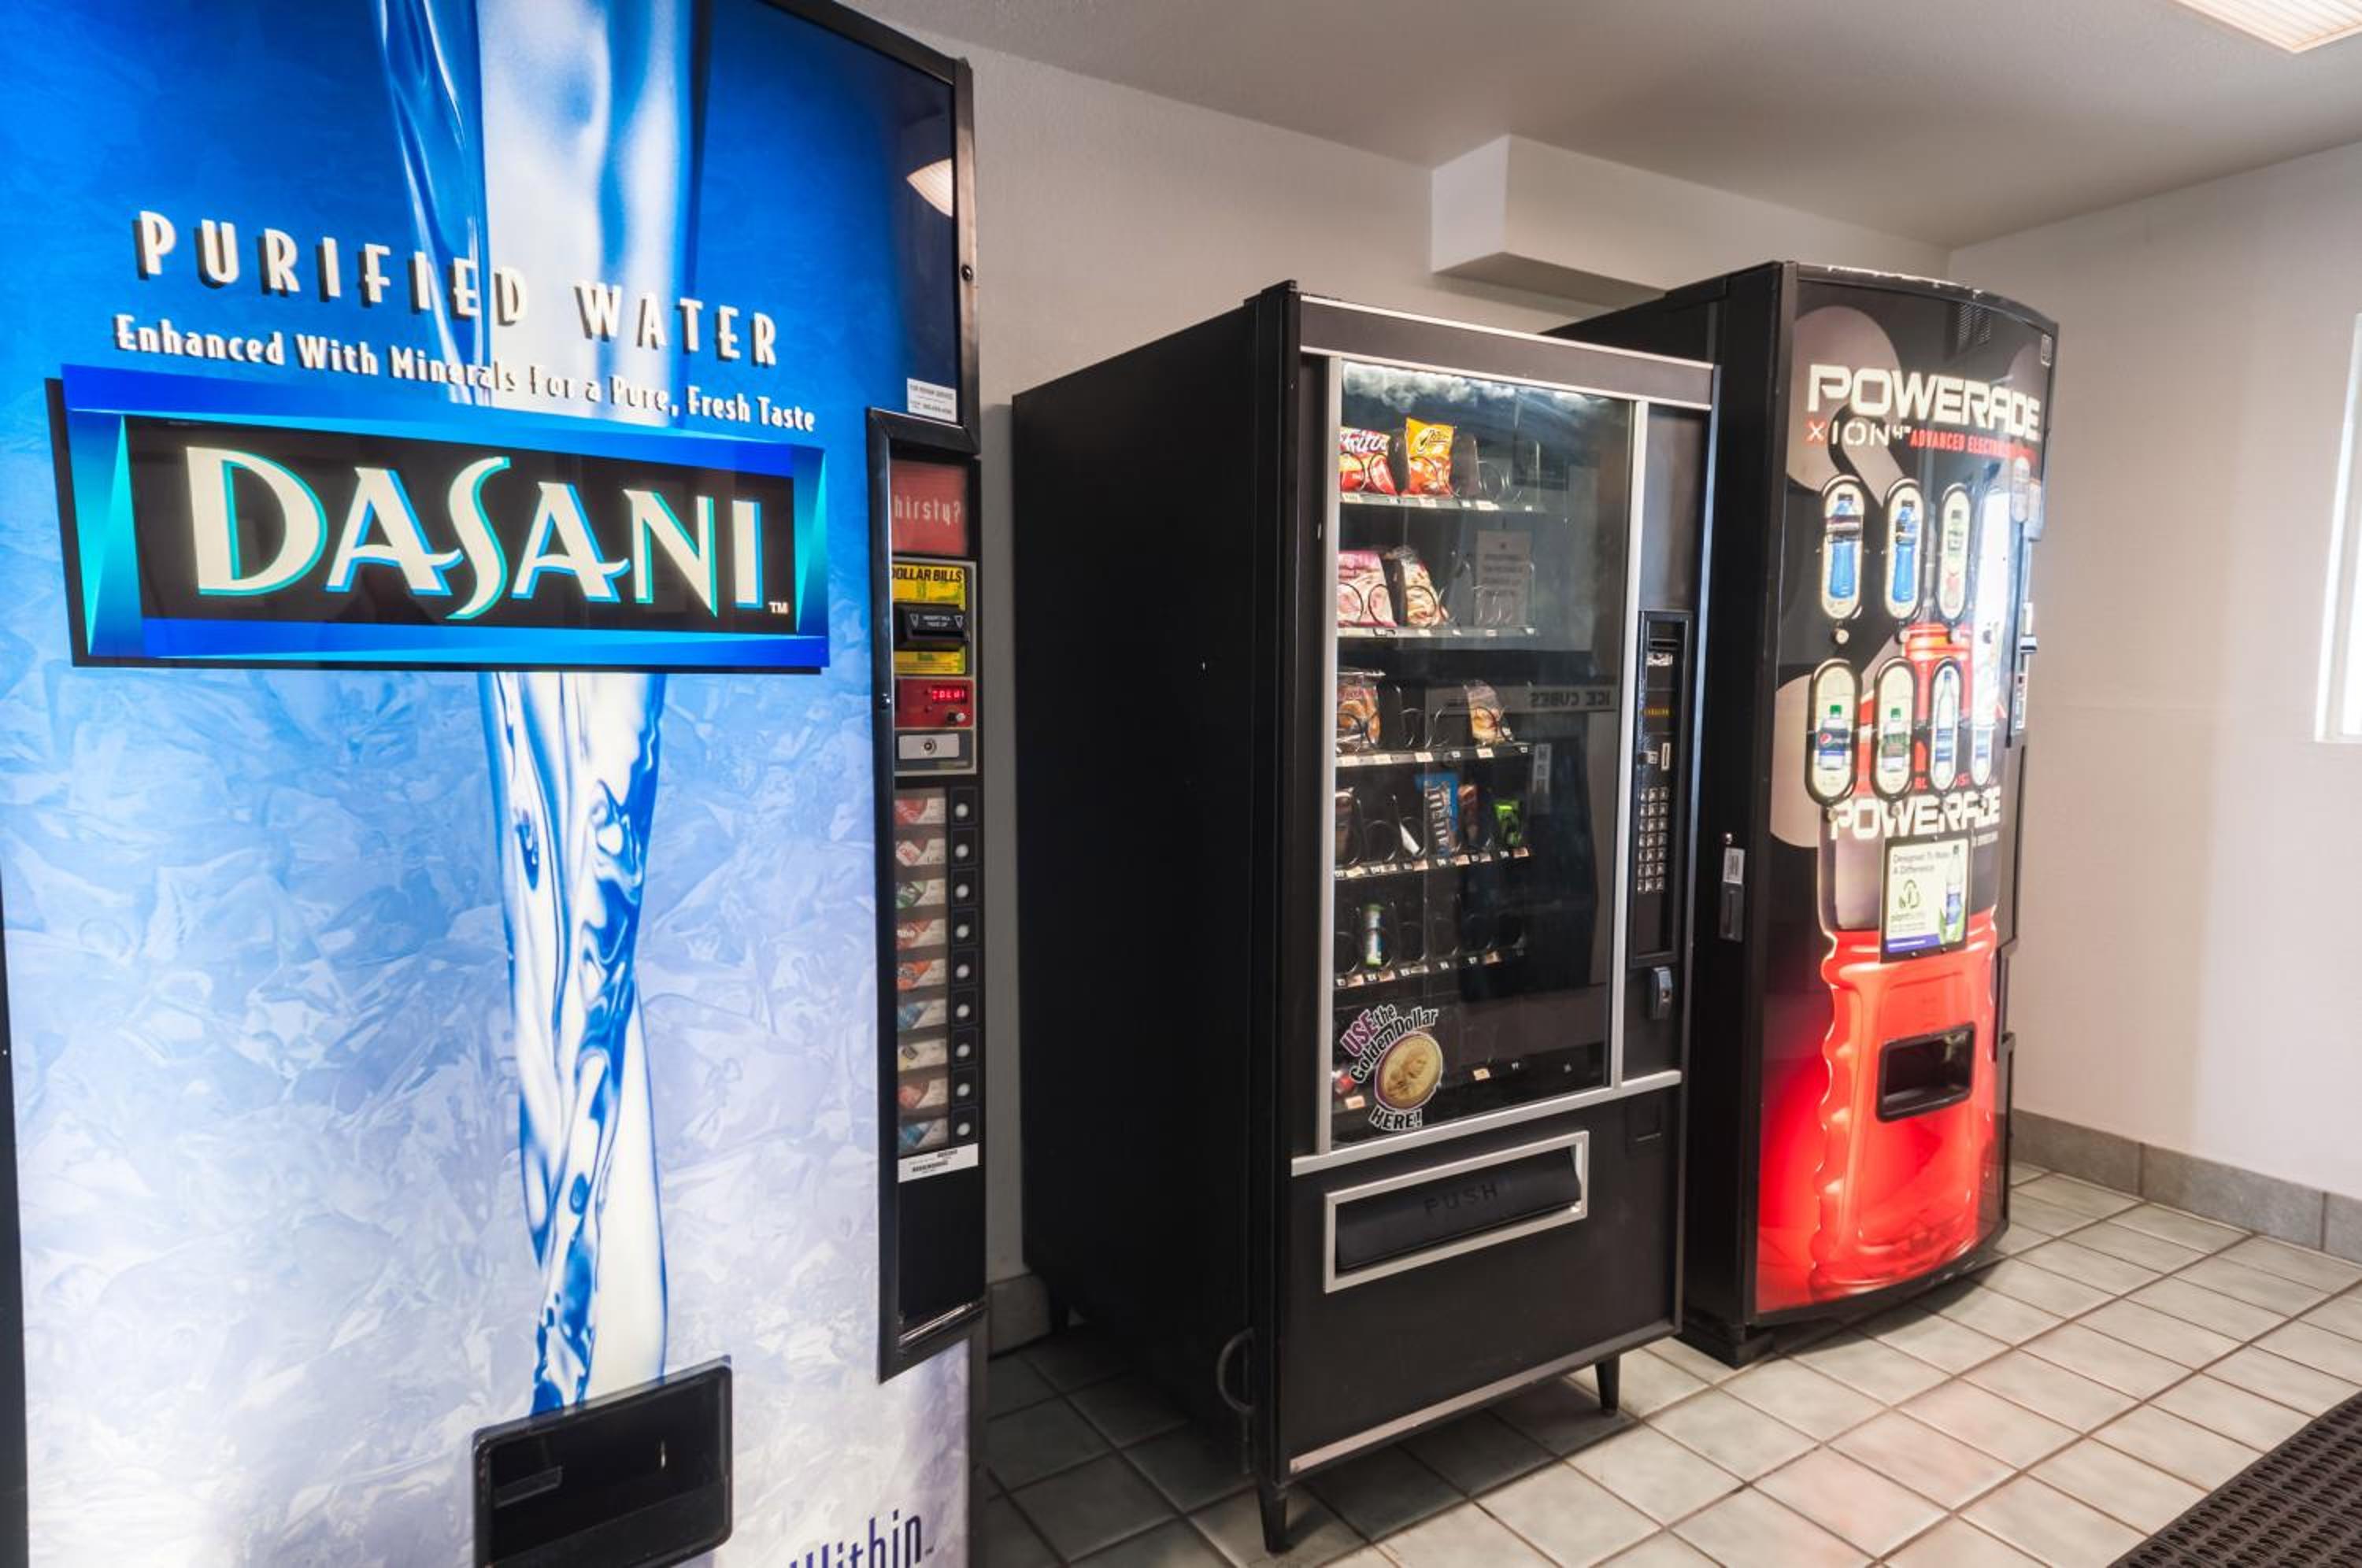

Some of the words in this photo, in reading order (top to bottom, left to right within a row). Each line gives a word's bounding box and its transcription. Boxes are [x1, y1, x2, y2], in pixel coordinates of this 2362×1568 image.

[135, 209, 528, 327] PURIFIED
[574, 279, 778, 366] WATER
[113, 313, 284, 365] Enhanced
[295, 333, 379, 376] With
[391, 344, 516, 392] Minerals
[530, 362, 576, 398] For
[584, 378, 600, 402] a
[609, 373, 679, 417] Pure,
[687, 385, 750, 423] Fresh
[756, 394, 816, 433] Taste
[1807, 364, 2041, 442] POWERADE
[1909, 429, 1966, 453] ADVANCED
[186, 444, 765, 621] DASANI
[894, 494, 961, 526] hirsty?
[933, 569, 962, 582] BILLS
[1830, 786, 2001, 841] POWERADE
[1340, 1010, 1379, 1056] USE
[1373, 1004, 1397, 1029] the
[1349, 1024, 1395, 1082] Golden
[1394, 1007, 1438, 1037] Dollar
[1369, 1108, 1423, 1130] HERE!
[1423, 1182, 1499, 1215] PUSH
